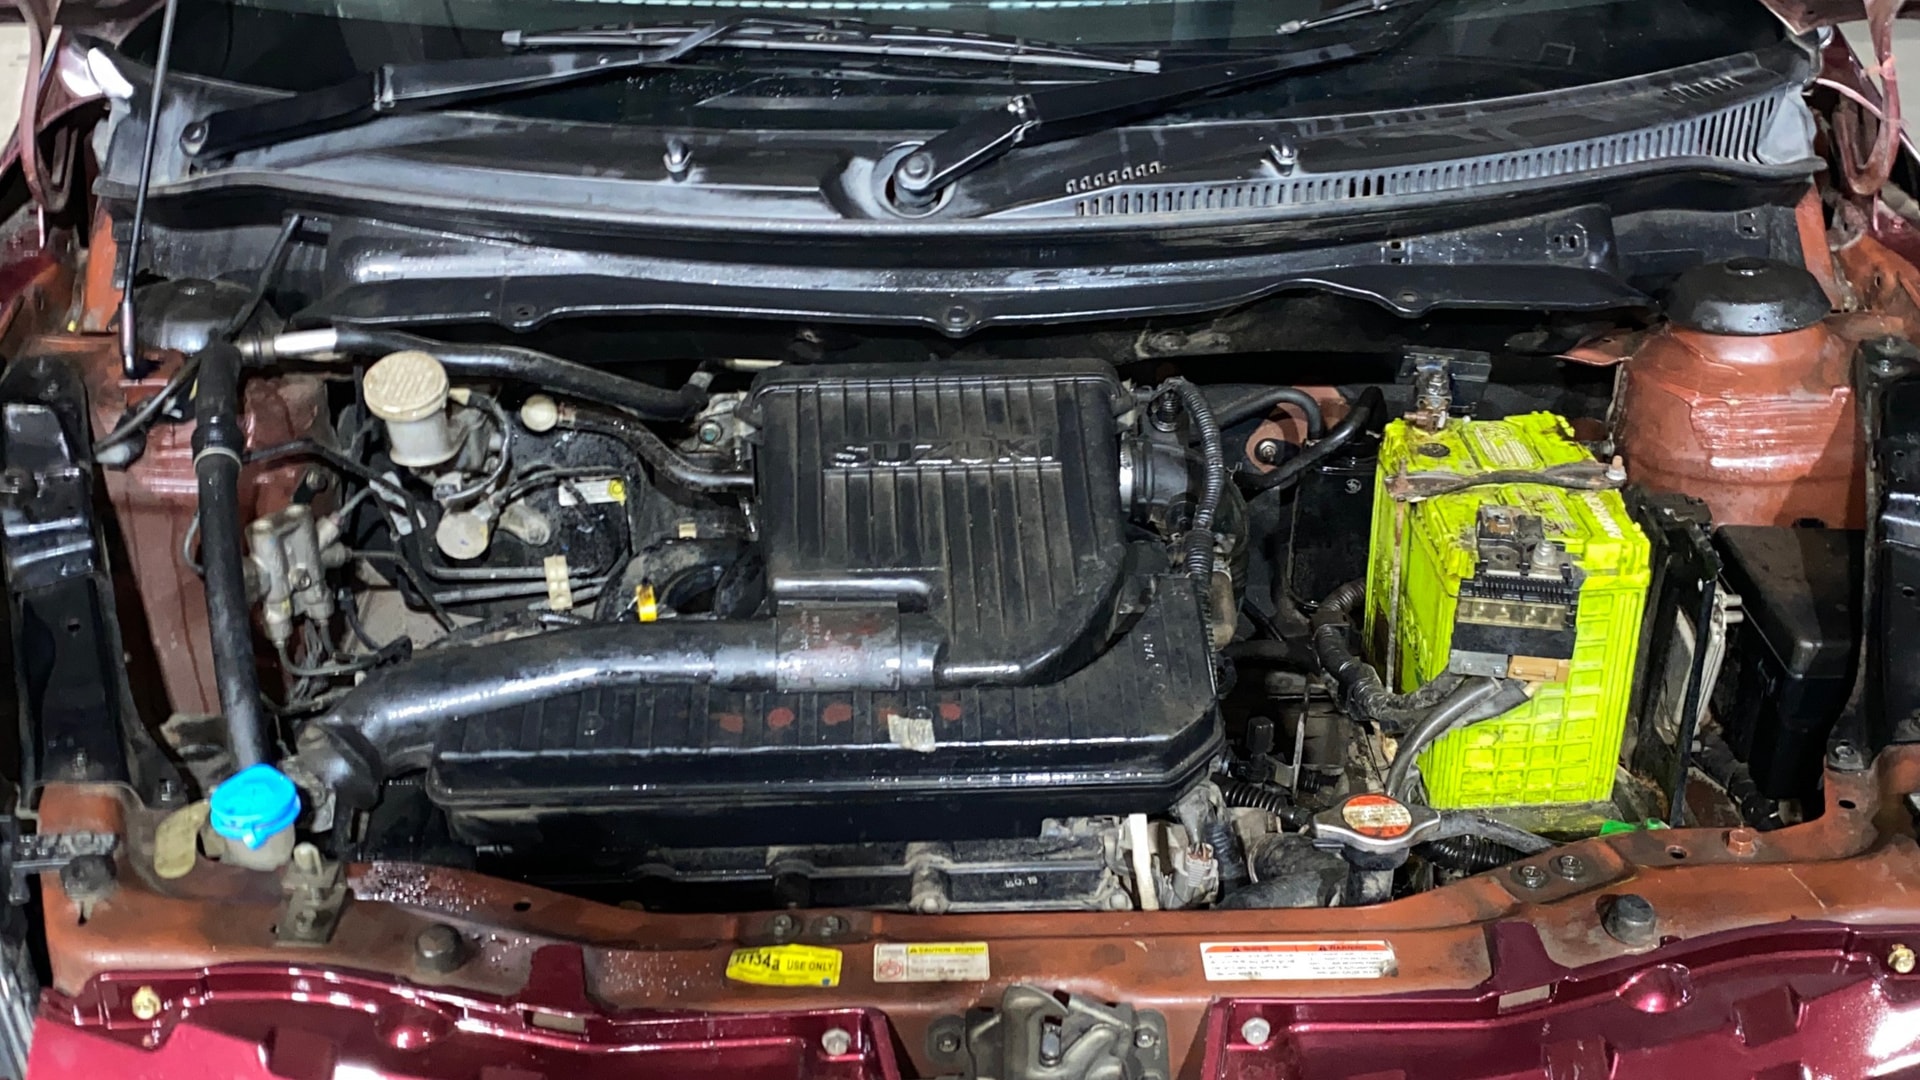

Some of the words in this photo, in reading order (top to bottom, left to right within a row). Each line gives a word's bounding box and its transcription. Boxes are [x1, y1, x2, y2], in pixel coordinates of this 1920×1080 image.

[1583, 491, 1625, 540] AMARON
[787, 959, 806, 970] USE
[808, 961, 834, 971] ONLY
